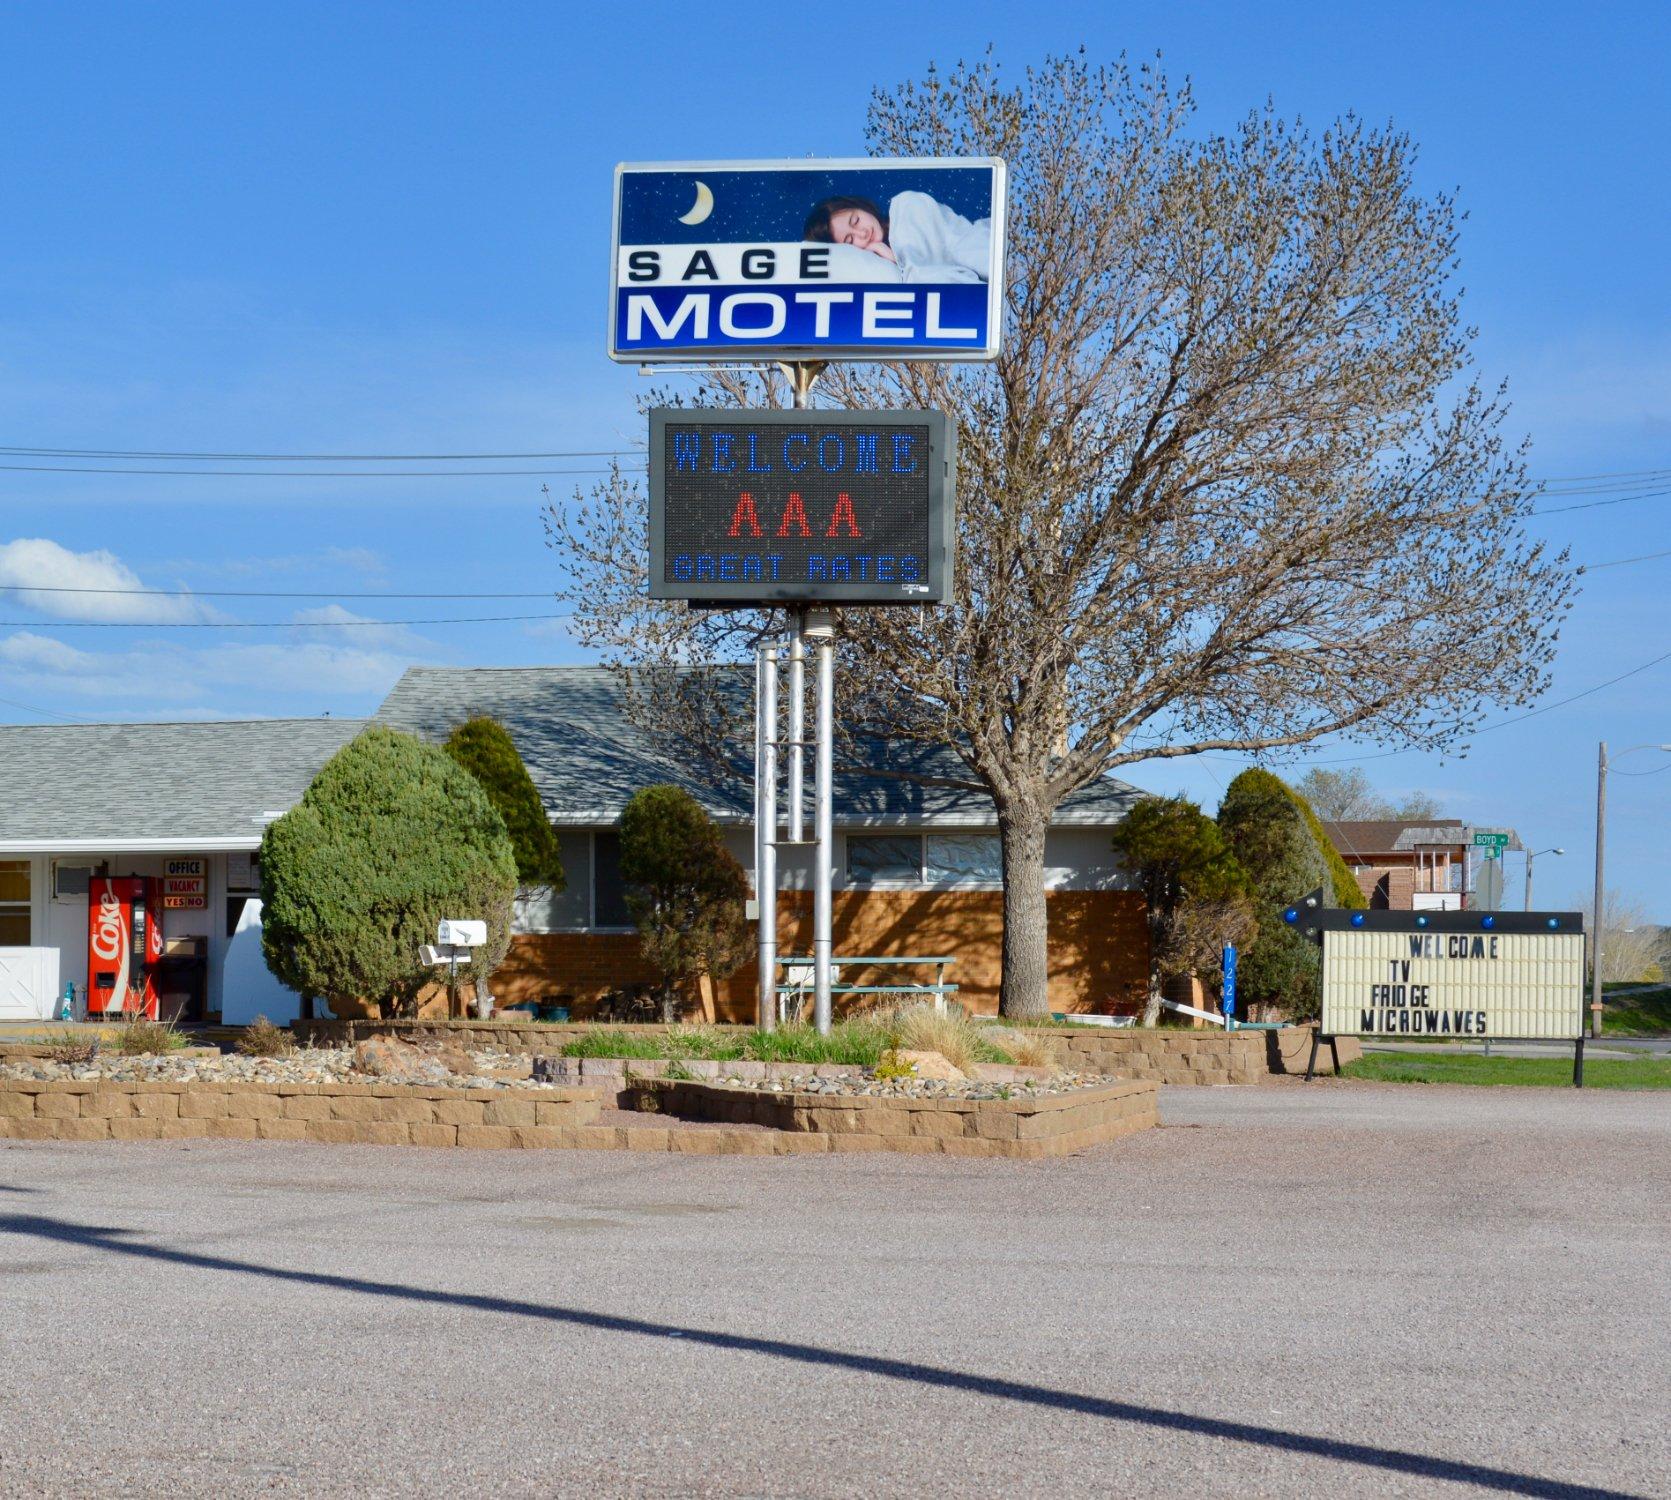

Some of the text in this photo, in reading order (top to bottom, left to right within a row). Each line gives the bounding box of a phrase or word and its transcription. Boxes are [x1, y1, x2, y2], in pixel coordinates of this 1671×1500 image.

[628, 248, 830, 282] SAGE
[626, 291, 978, 341] MOTEL
[673, 431, 918, 474] WELCOME
[727, 491, 863, 537] AAA
[673, 553, 921, 581] GREAT RATES
[1476, 835, 1497, 845] BOYD
[168, 861, 200, 874] OFFICE
[168, 879, 201, 893] VACANCY
[166, 898, 204, 907] YES NO
[91, 892, 120, 960] Coke
[1408, 935, 1498, 959] WELCOME
[1226, 950, 1234, 1012] 1227
[1389, 959, 1411, 983] TV
[1371, 984, 1430, 1008] FRIDGE
[1360, 1008, 1487, 1034] MICROWAVES
